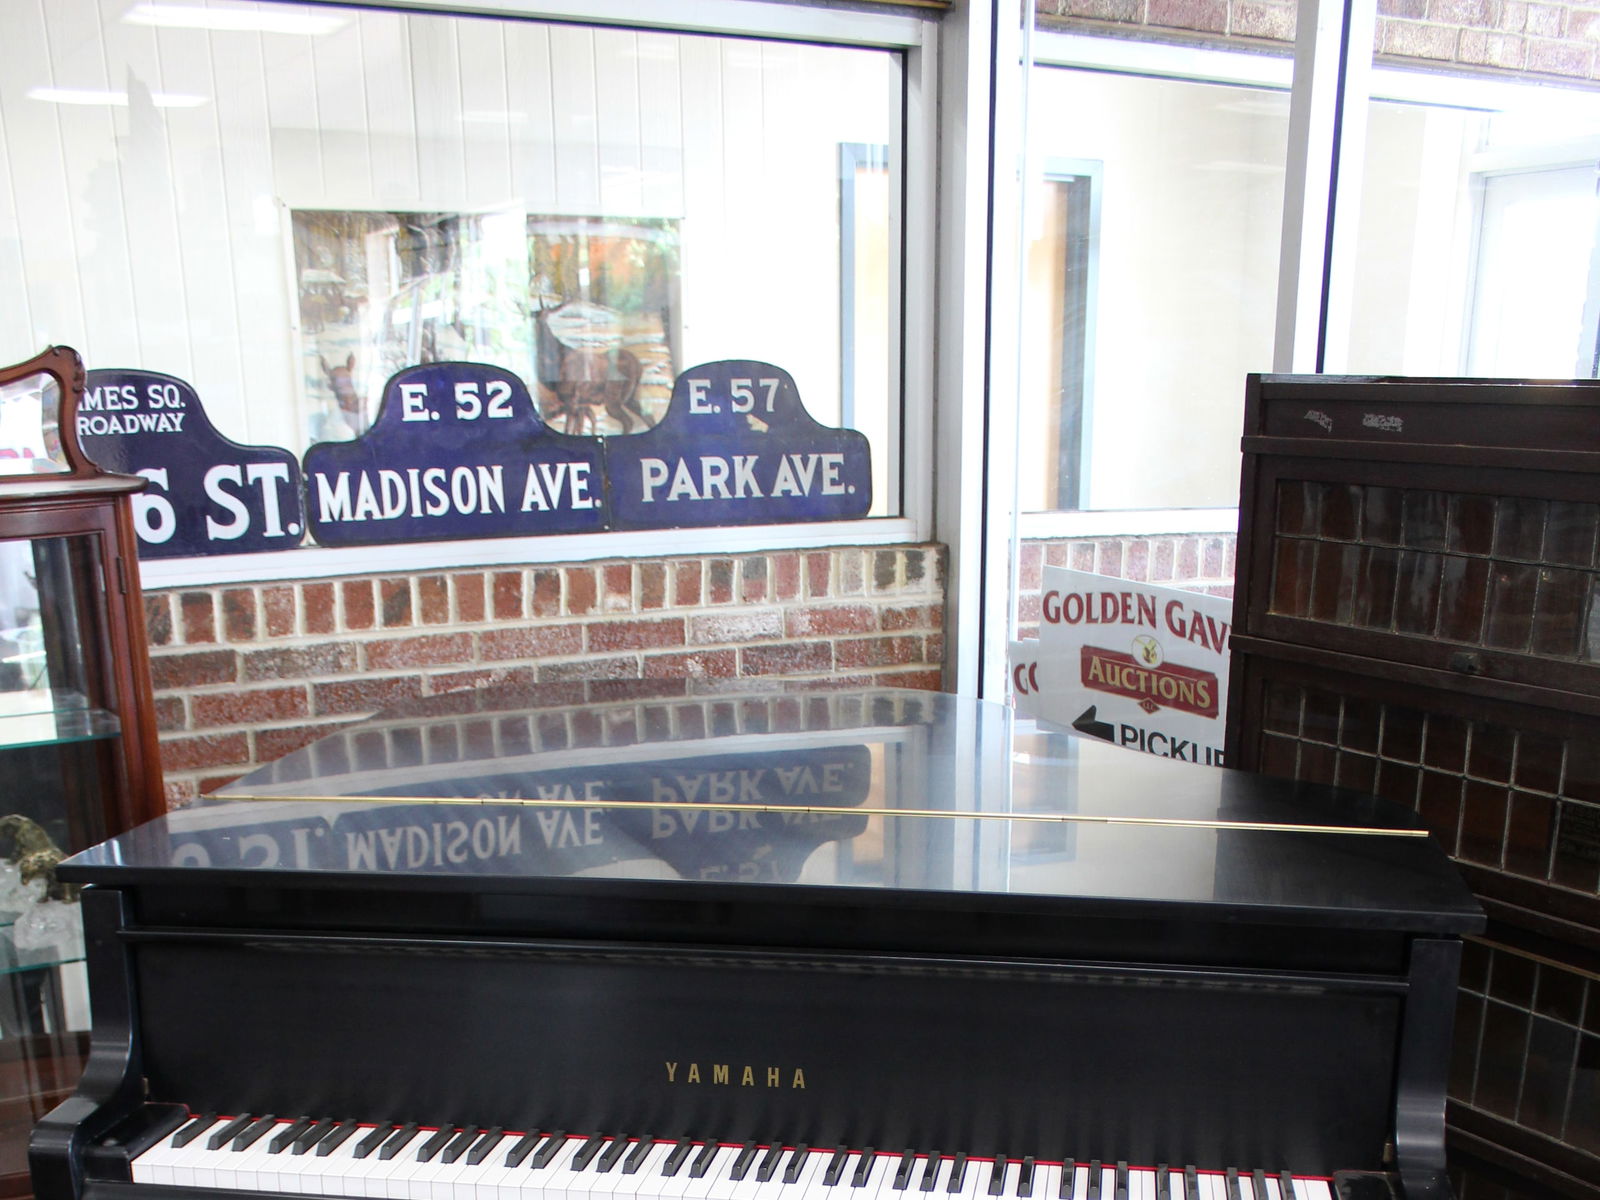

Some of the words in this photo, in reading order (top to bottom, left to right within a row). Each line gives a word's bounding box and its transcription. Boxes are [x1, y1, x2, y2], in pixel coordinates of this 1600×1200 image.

[78, 385, 139, 411] MES
[147, 384, 186, 409] SQ.
[398, 383, 441, 422] E.
[454, 380, 514, 420] 52
[688, 377, 722, 415] E.
[729, 376, 781, 413] 57
[132, 467, 177, 544] 6
[204, 462, 300, 541] ST.
[315, 464, 505, 523] MADISON
[520, 461, 602, 512] AVE.
[640, 453, 765, 503] PARK
[770, 452, 856, 498] AVE.
[1042, 590, 1157, 629] GOLDEN
[1165, 600, 1231, 656] GAV
[1088, 655, 1211, 709] AUCTIONS
[665, 1061, 806, 1089] YAMAHA
